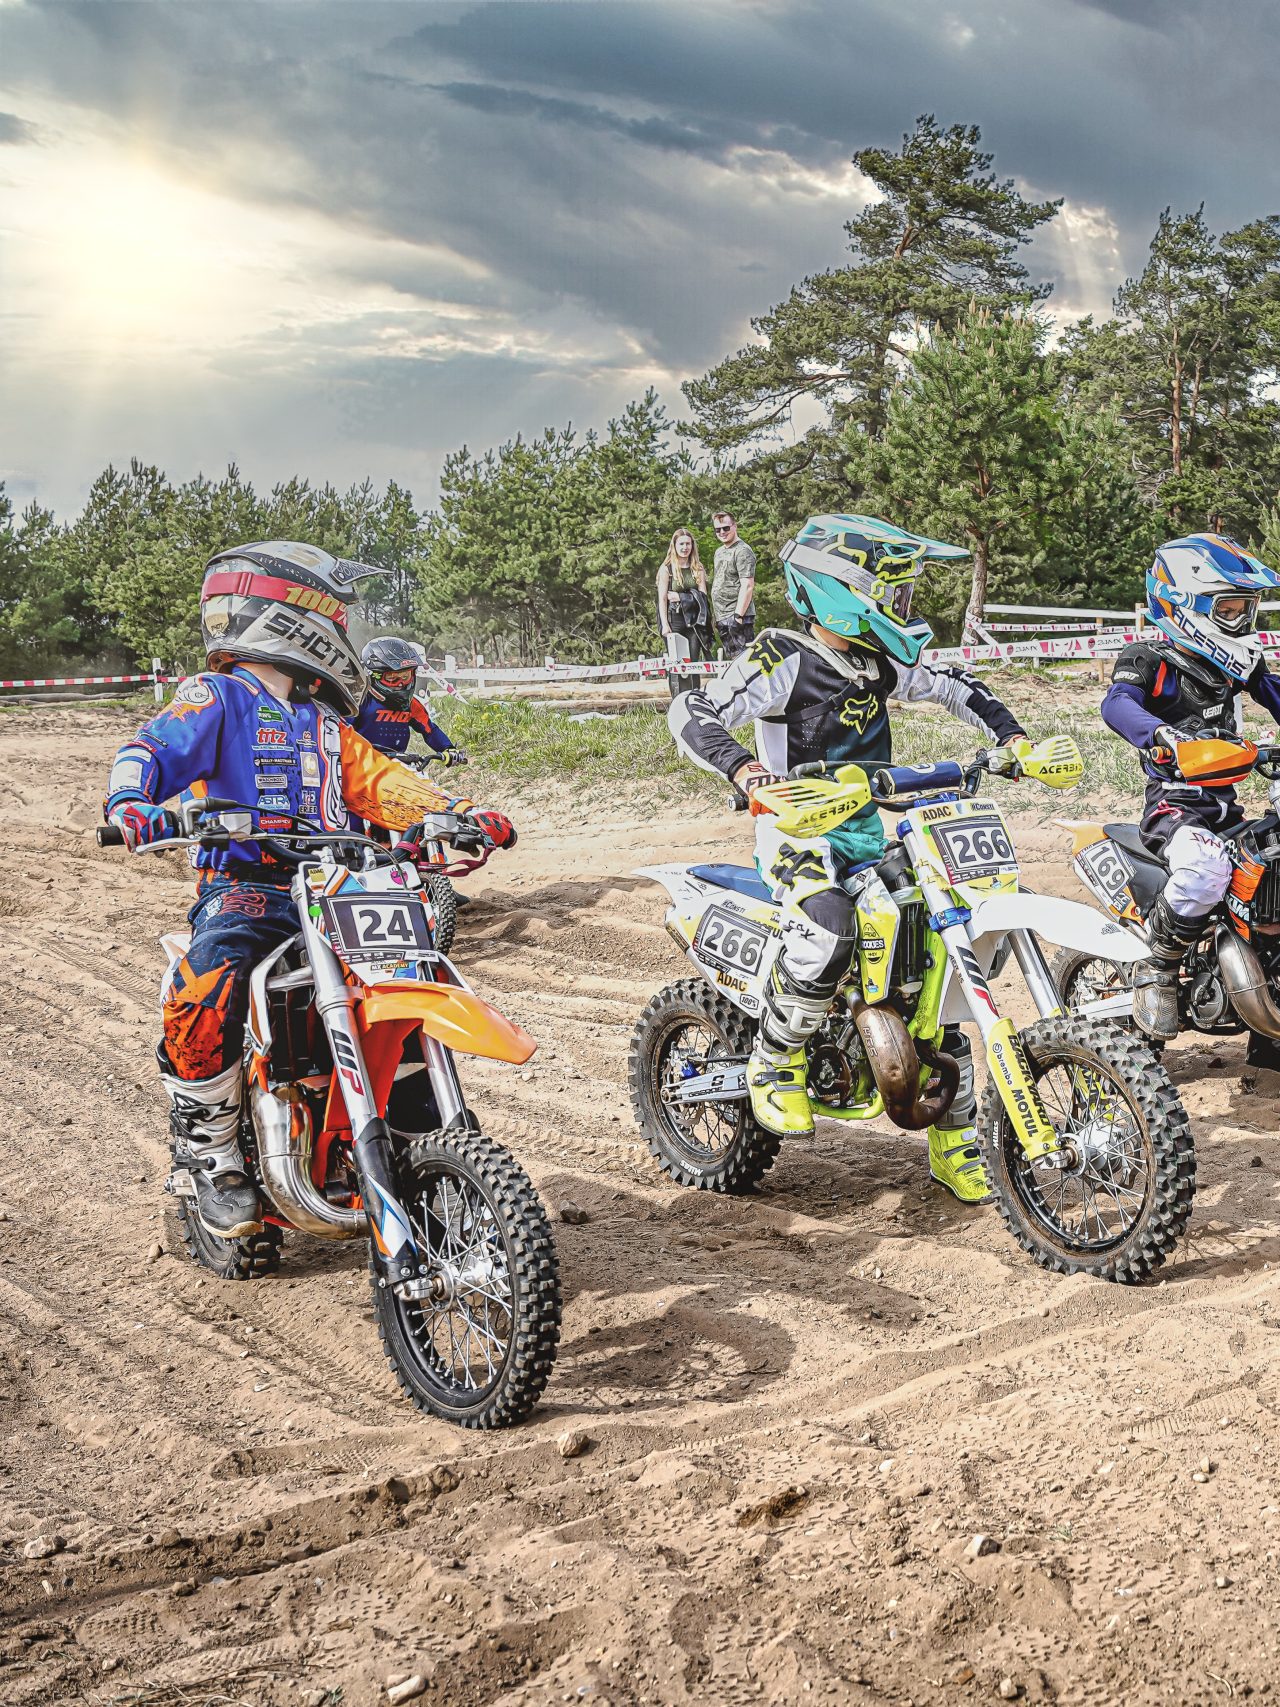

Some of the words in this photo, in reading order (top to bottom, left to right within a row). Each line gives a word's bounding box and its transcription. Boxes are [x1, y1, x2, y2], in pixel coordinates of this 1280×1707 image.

[262, 611, 347, 668] SHOT
[375, 709, 412, 723] THO
[922, 805, 952, 822] ADAC
[952, 828, 1012, 864] 266
[1090, 846, 1126, 890] 169
[358, 909, 414, 943] 24
[703, 921, 761, 967] 266
[716, 971, 748, 993] ADAC
[996, 1052, 1014, 1086] brembo
[1007, 1034, 1052, 1127] BACKYARD
[1011, 1088, 1040, 1138] MOTUL
